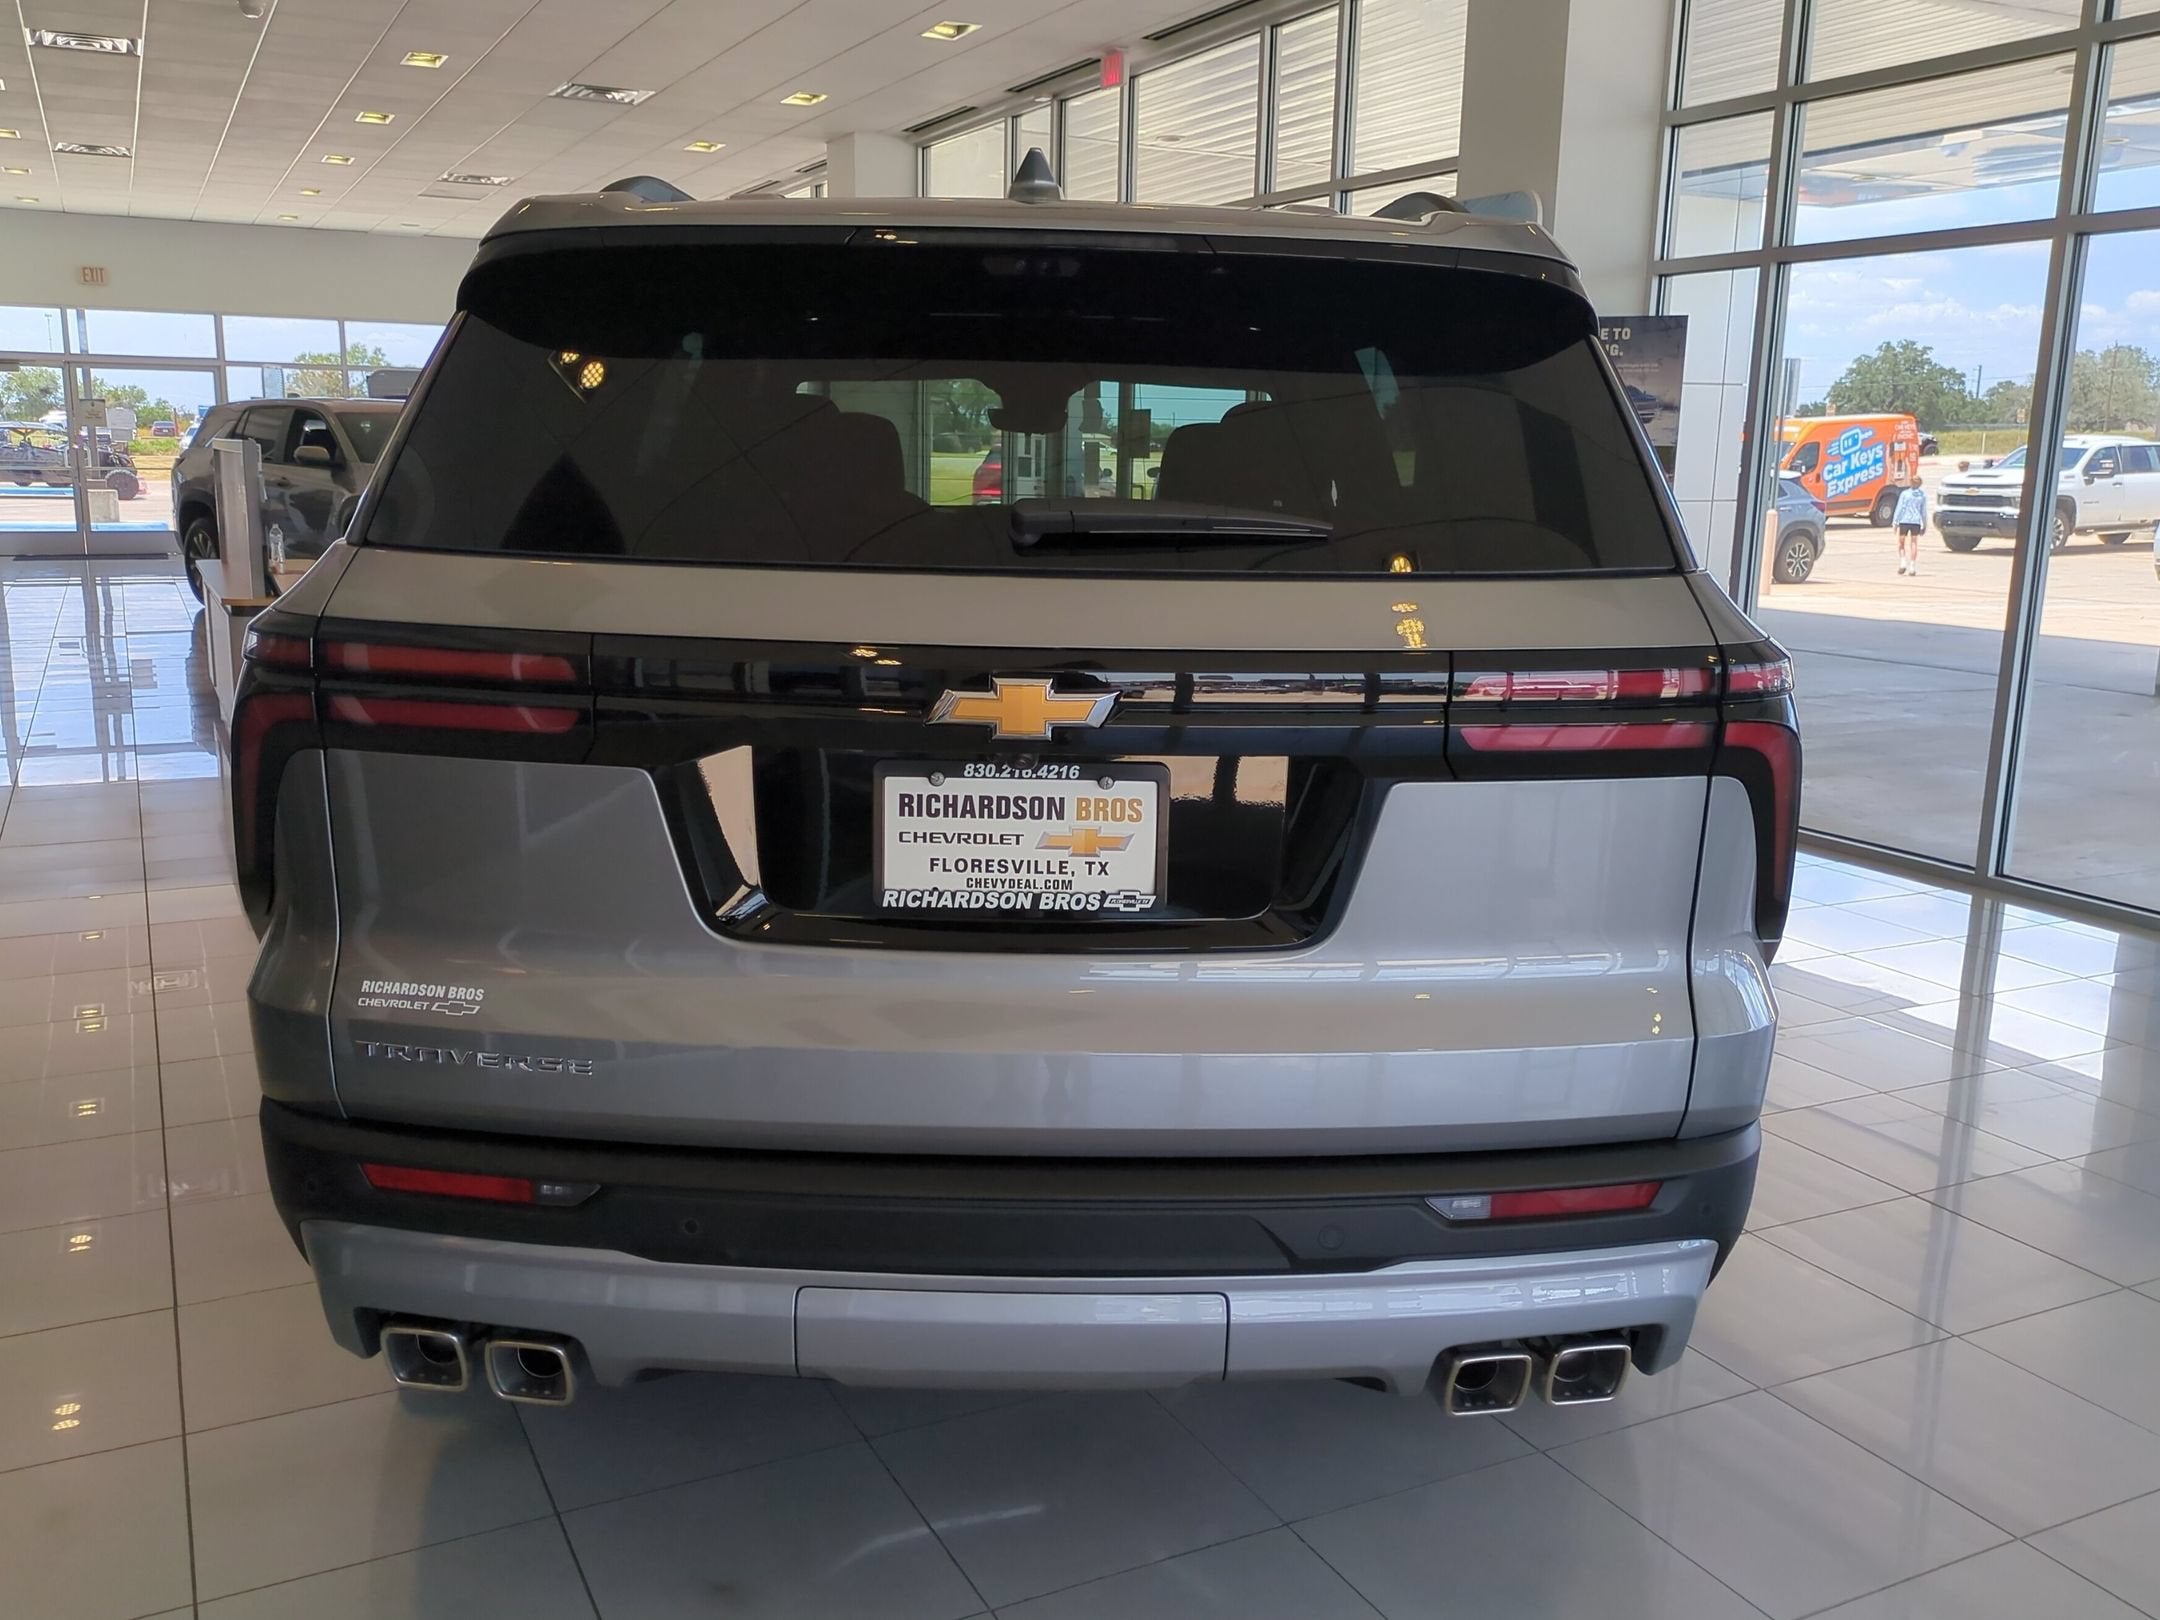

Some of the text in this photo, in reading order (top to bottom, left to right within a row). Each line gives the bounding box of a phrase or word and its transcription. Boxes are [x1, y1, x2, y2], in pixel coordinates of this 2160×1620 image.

[82, 266, 104, 283] EXIT
[1612, 328, 1631, 340] TO
[1823, 461, 1847, 480] Car
[1851, 444, 1884, 470] Keys
[1827, 463, 1884, 498] Express
[898, 793, 1143, 823] RICHARDSON BROS
[898, 831, 1025, 846] CHEVROLET
[929, 858, 1110, 877] FLORESVILLE, TX
[966, 877, 1073, 891] CHEVYDEAL.COM
[882, 890, 1101, 911] RICHARDSON BROS
[361, 980, 485, 1002] RICHARDSON BROS
[358, 997, 429, 1011] CHEVROLET
[355, 1040, 593, 1076] TRAVERSE
